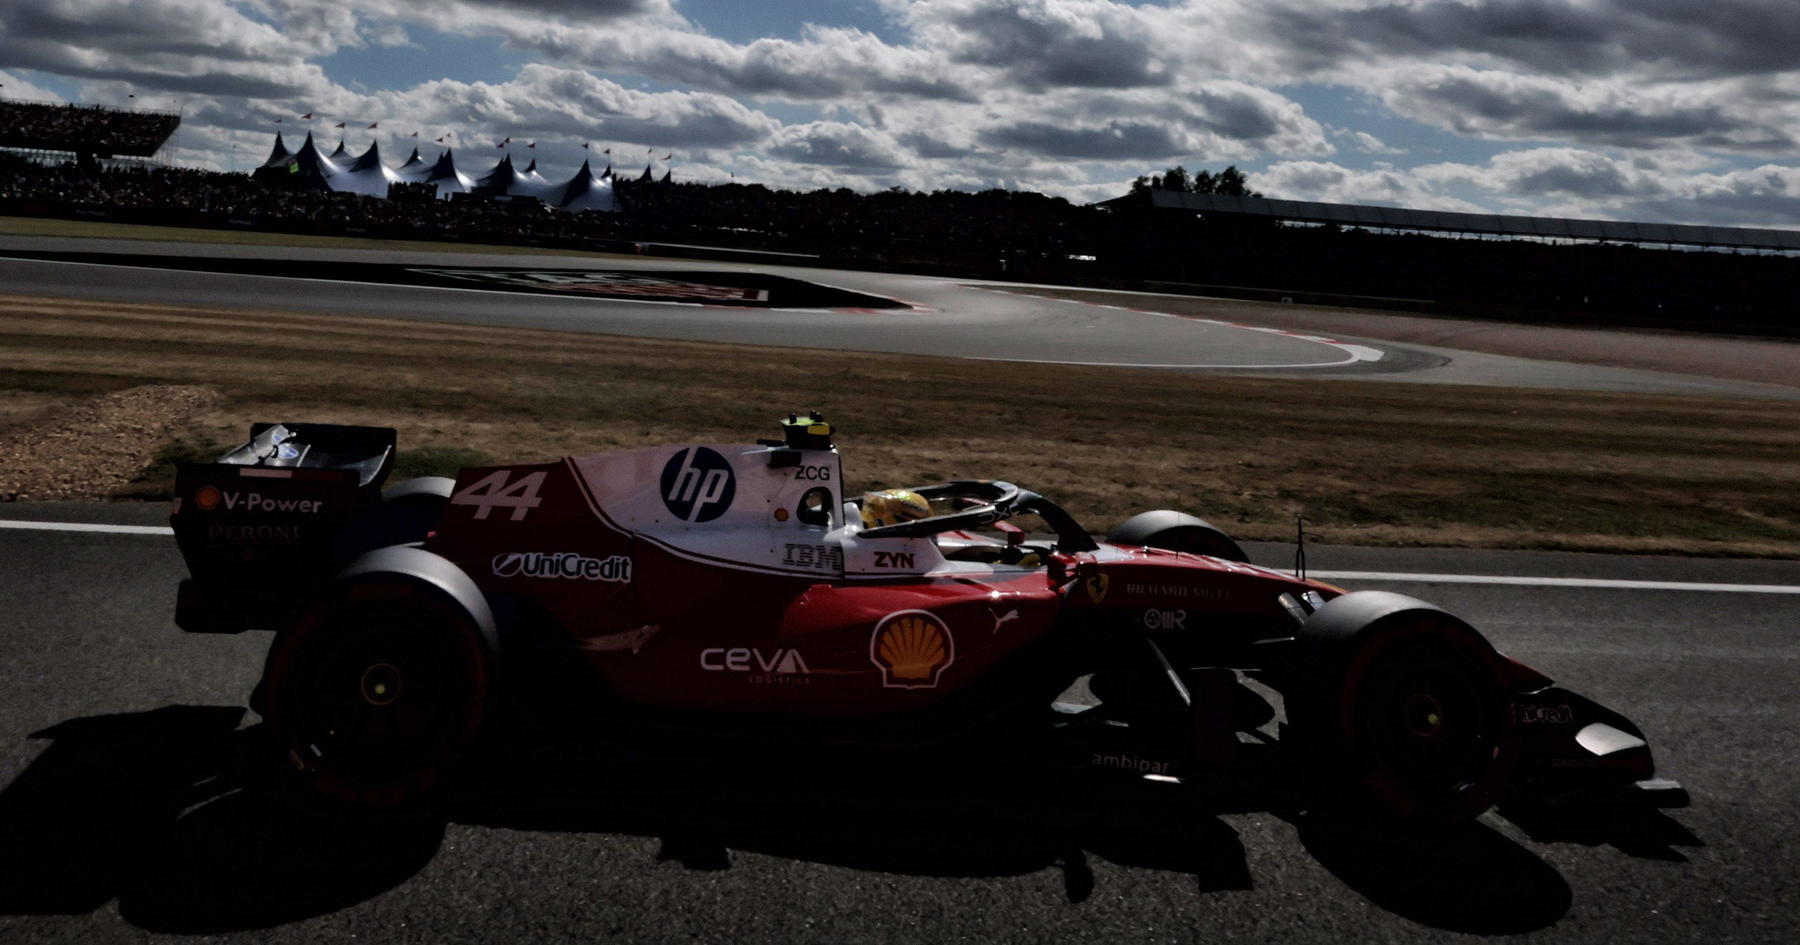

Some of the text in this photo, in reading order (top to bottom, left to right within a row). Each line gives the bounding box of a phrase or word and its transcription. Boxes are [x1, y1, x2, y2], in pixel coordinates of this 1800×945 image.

[665, 447, 731, 522] hp
[794, 466, 831, 481] ZCG
[222, 491, 323, 513] V-Power
[450, 469, 549, 522] 44
[523, 554, 630, 580] UniCredit
[783, 543, 842, 571] IBM
[873, 551, 915, 569] ZYN
[1091, 752, 1171, 775] ambipar
